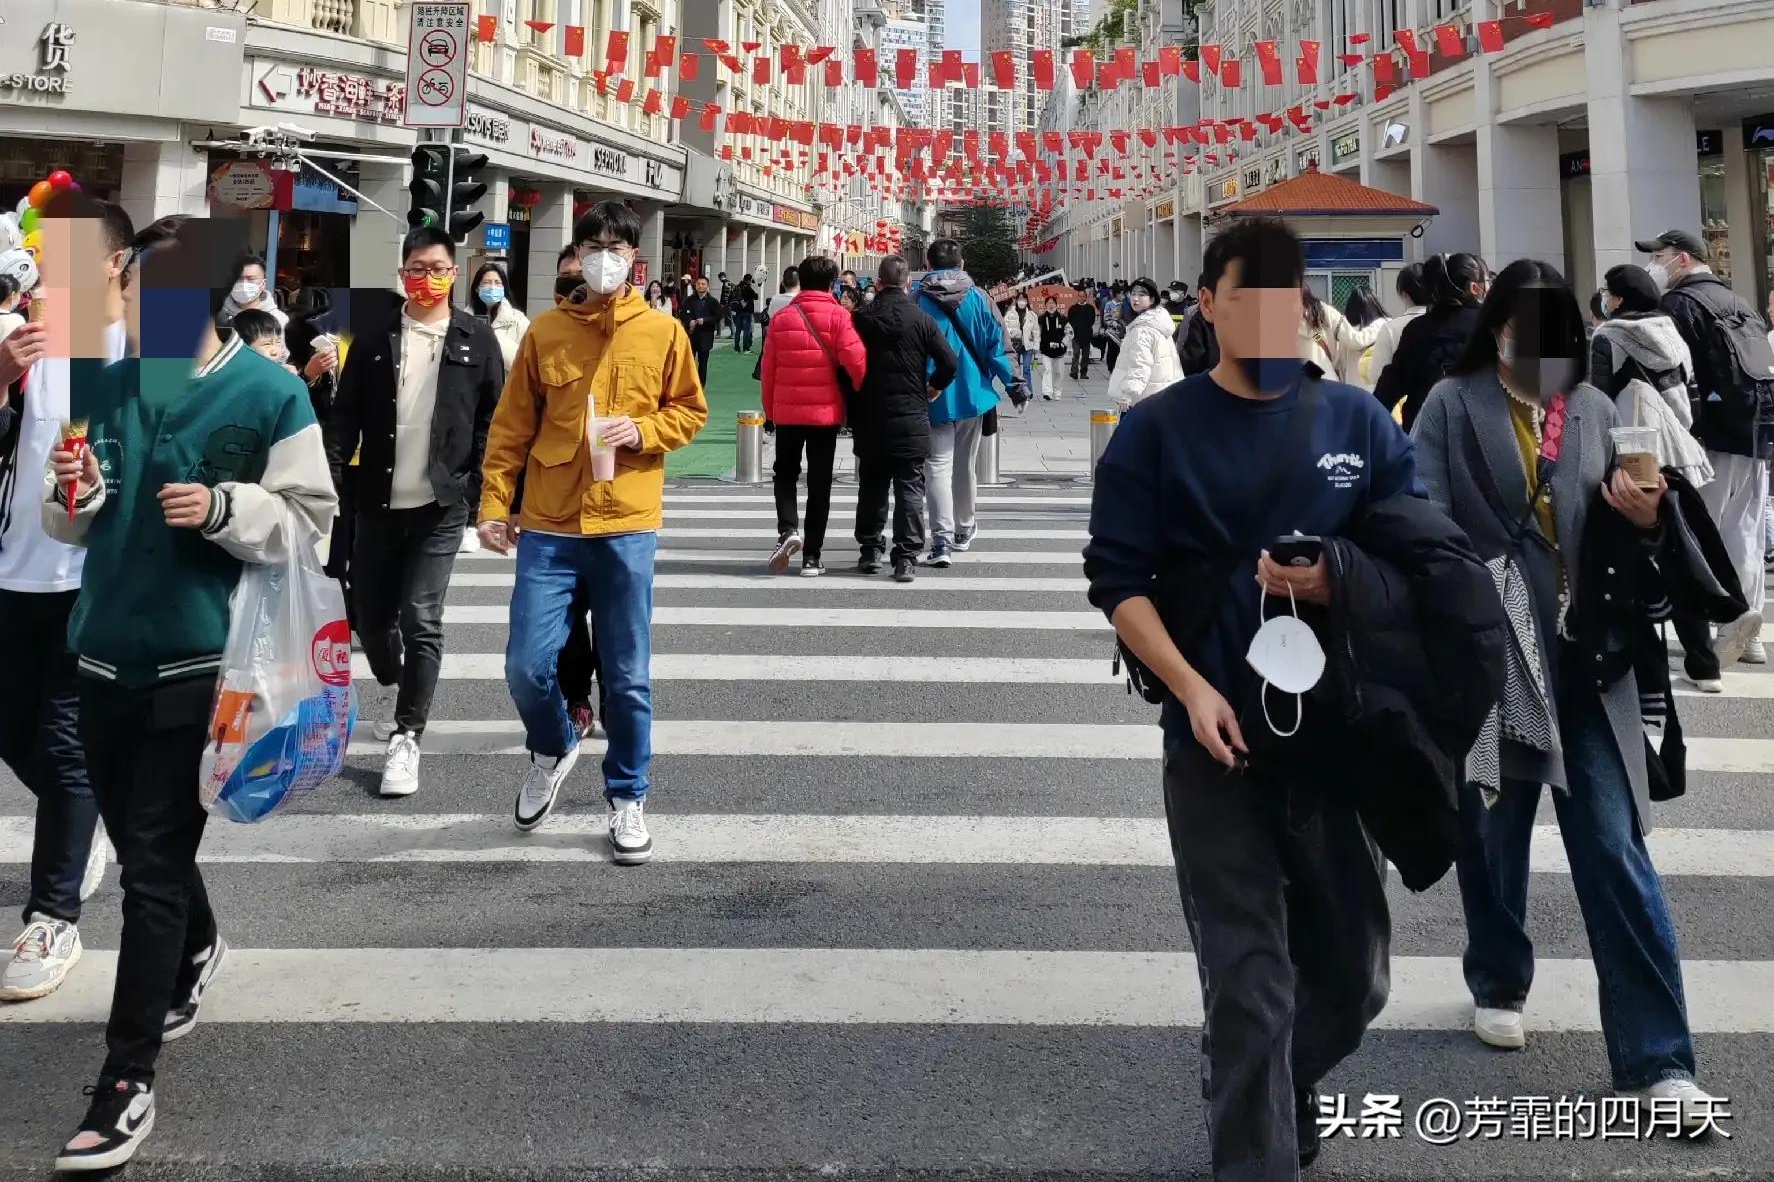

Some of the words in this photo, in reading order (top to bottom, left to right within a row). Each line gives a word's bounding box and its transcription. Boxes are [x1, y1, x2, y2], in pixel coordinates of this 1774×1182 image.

[417, 17, 463, 28] 请注意安全
